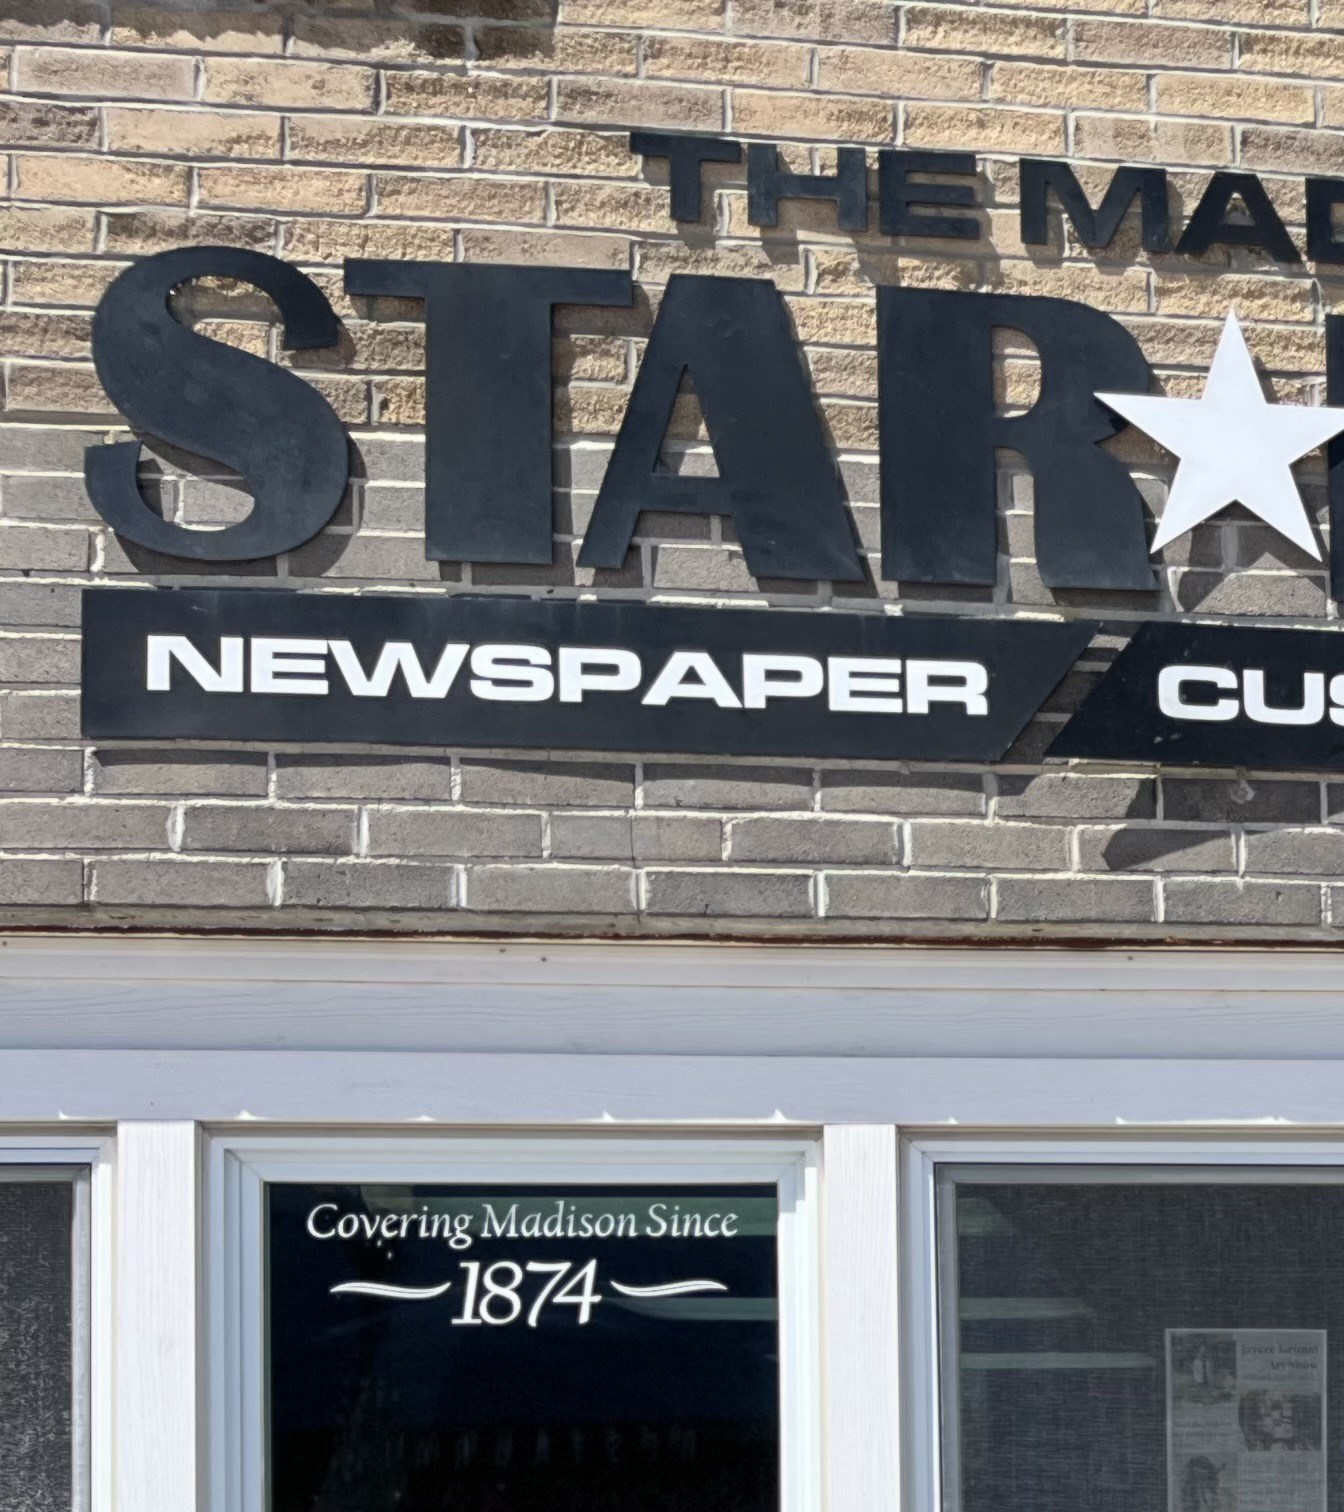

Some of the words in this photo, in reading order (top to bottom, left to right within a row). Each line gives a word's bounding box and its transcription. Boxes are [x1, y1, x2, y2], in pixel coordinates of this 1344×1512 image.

[630, 132, 981, 240] THE
[84, 245, 1162, 592] STAR
[145, 633, 990, 717] NEWSPAPER
[306, 1202, 474, 1250] Covering
[481, 1200, 637, 1239] Madison
[645, 1202, 739, 1238] Since
[451, 1258, 603, 1328] 1874
